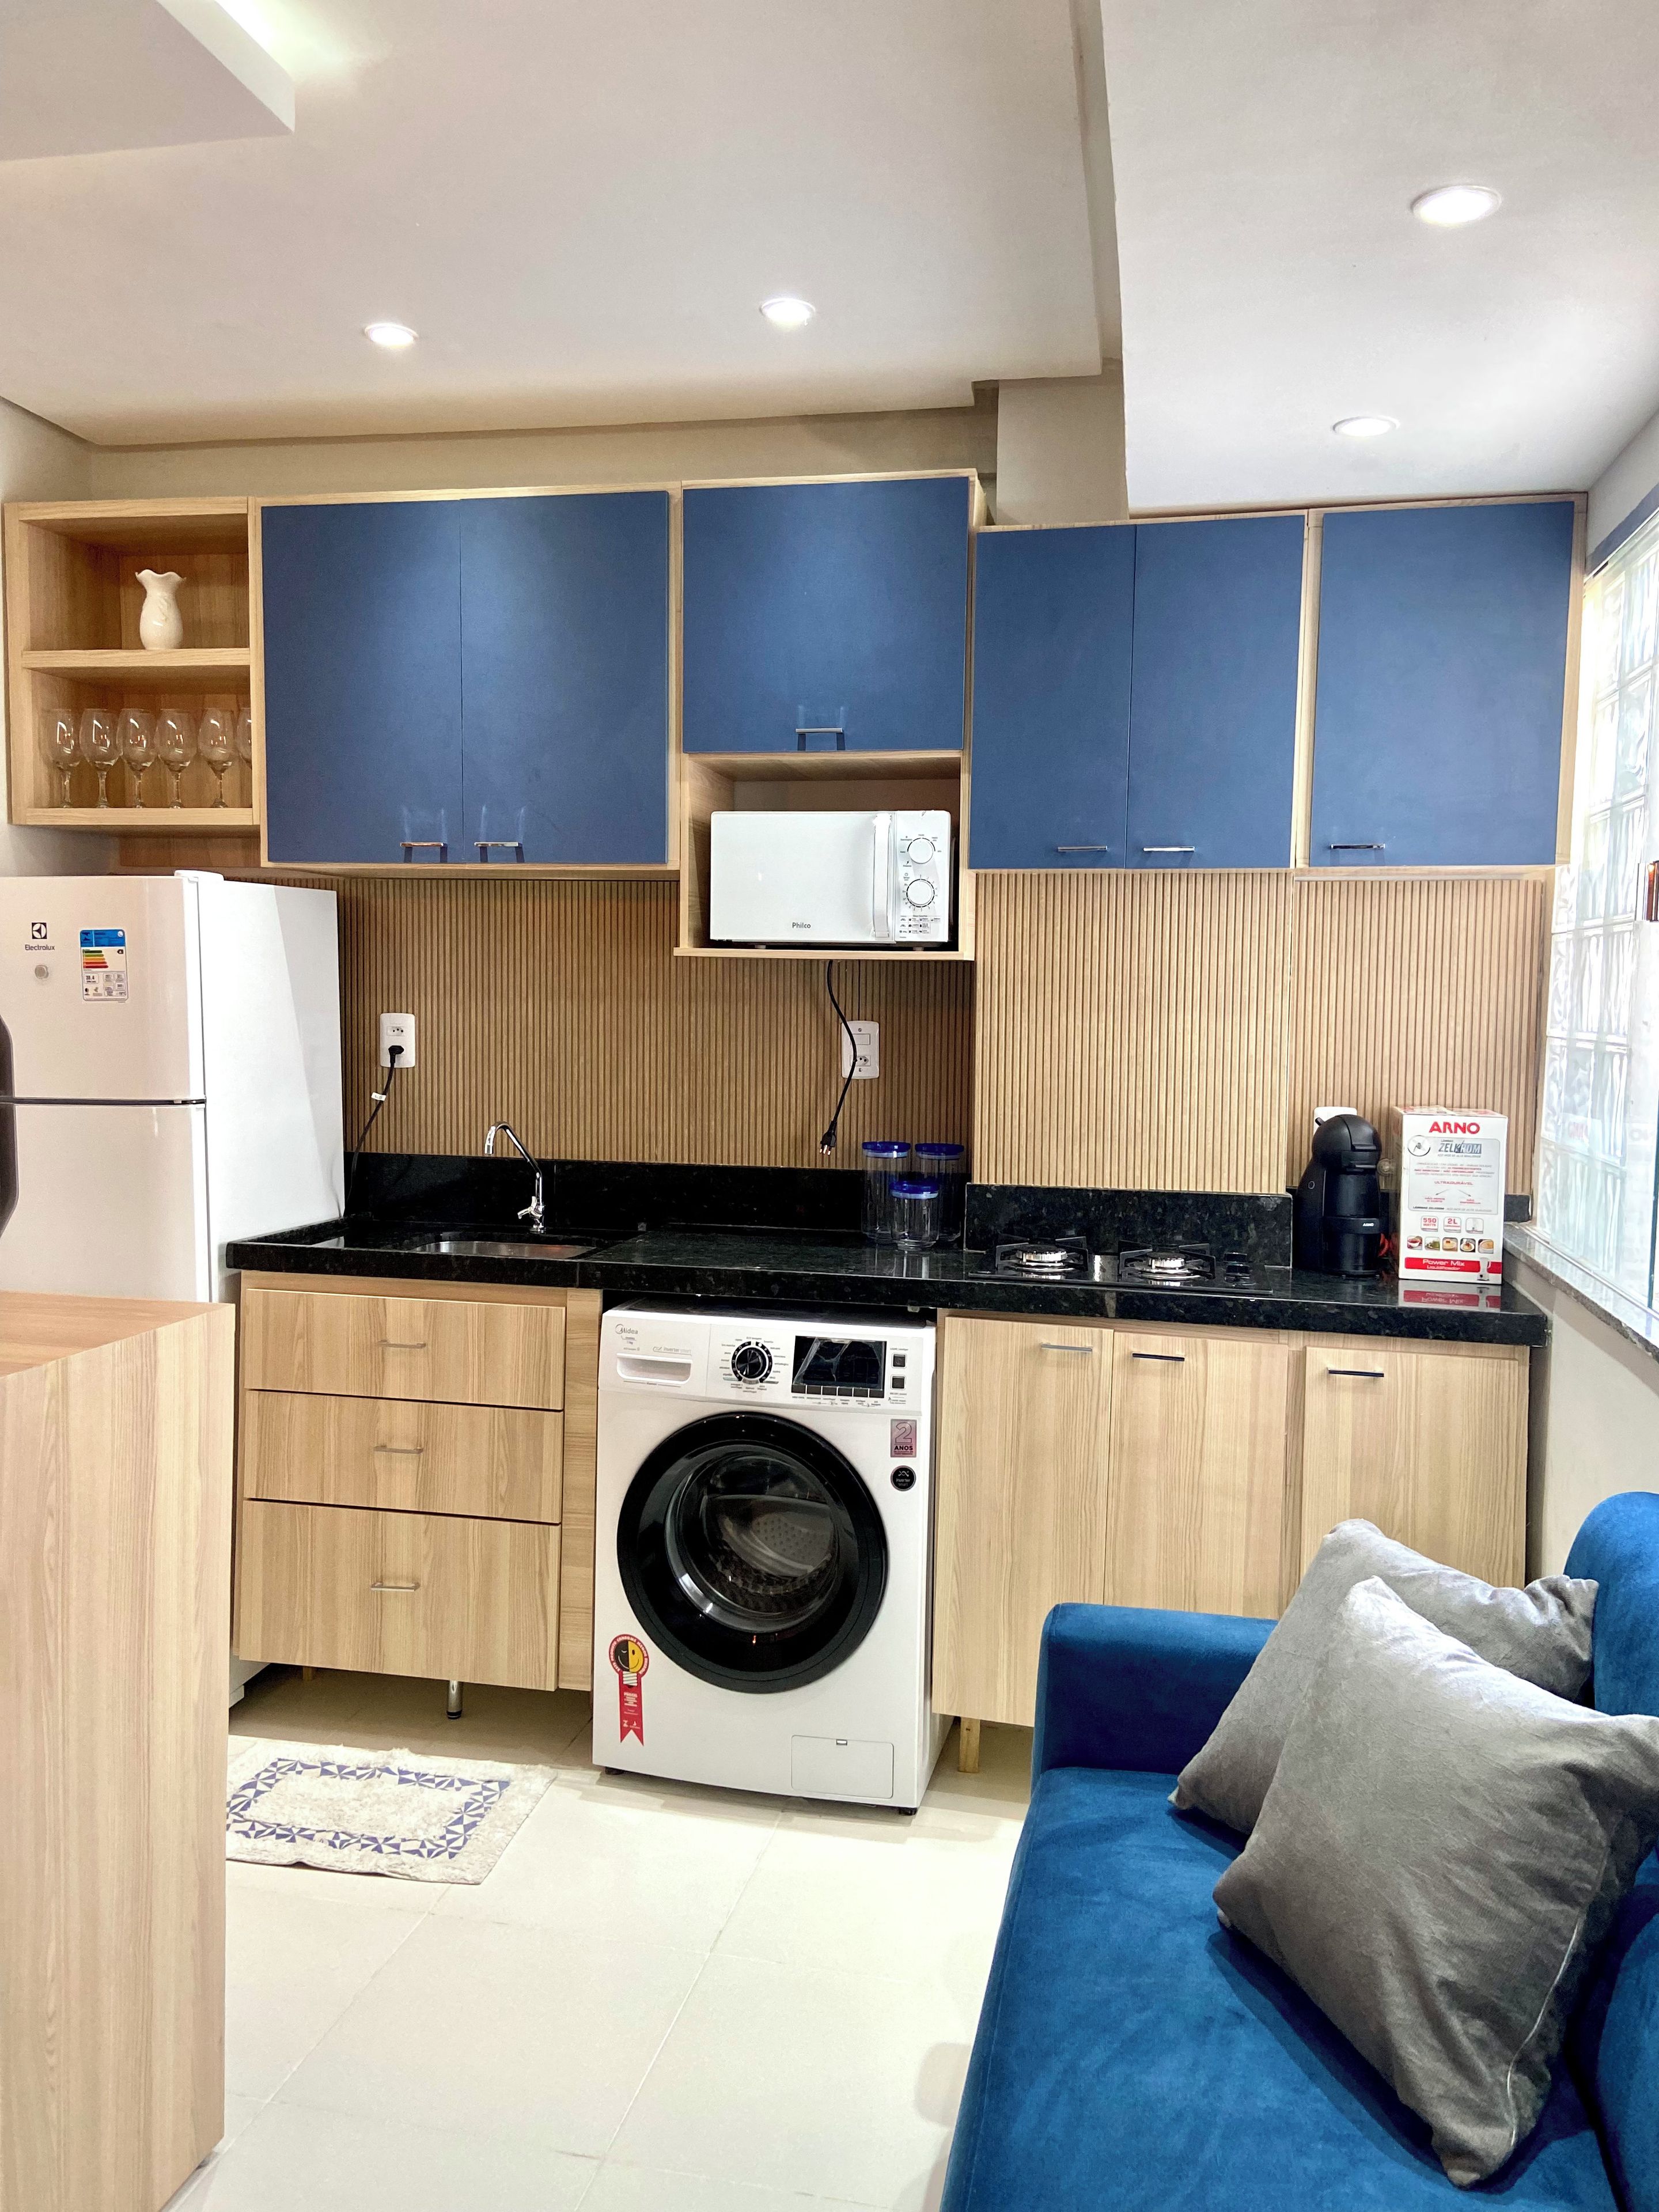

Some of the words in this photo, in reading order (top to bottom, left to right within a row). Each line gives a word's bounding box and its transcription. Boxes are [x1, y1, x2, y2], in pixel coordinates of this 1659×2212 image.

[1429, 1121, 1480, 1135] ARNO
[1438, 1142, 1482, 1154] ZELKROM
[615, 1324, 638, 1335] Midea
[895, 1422, 912, 1444] 2
